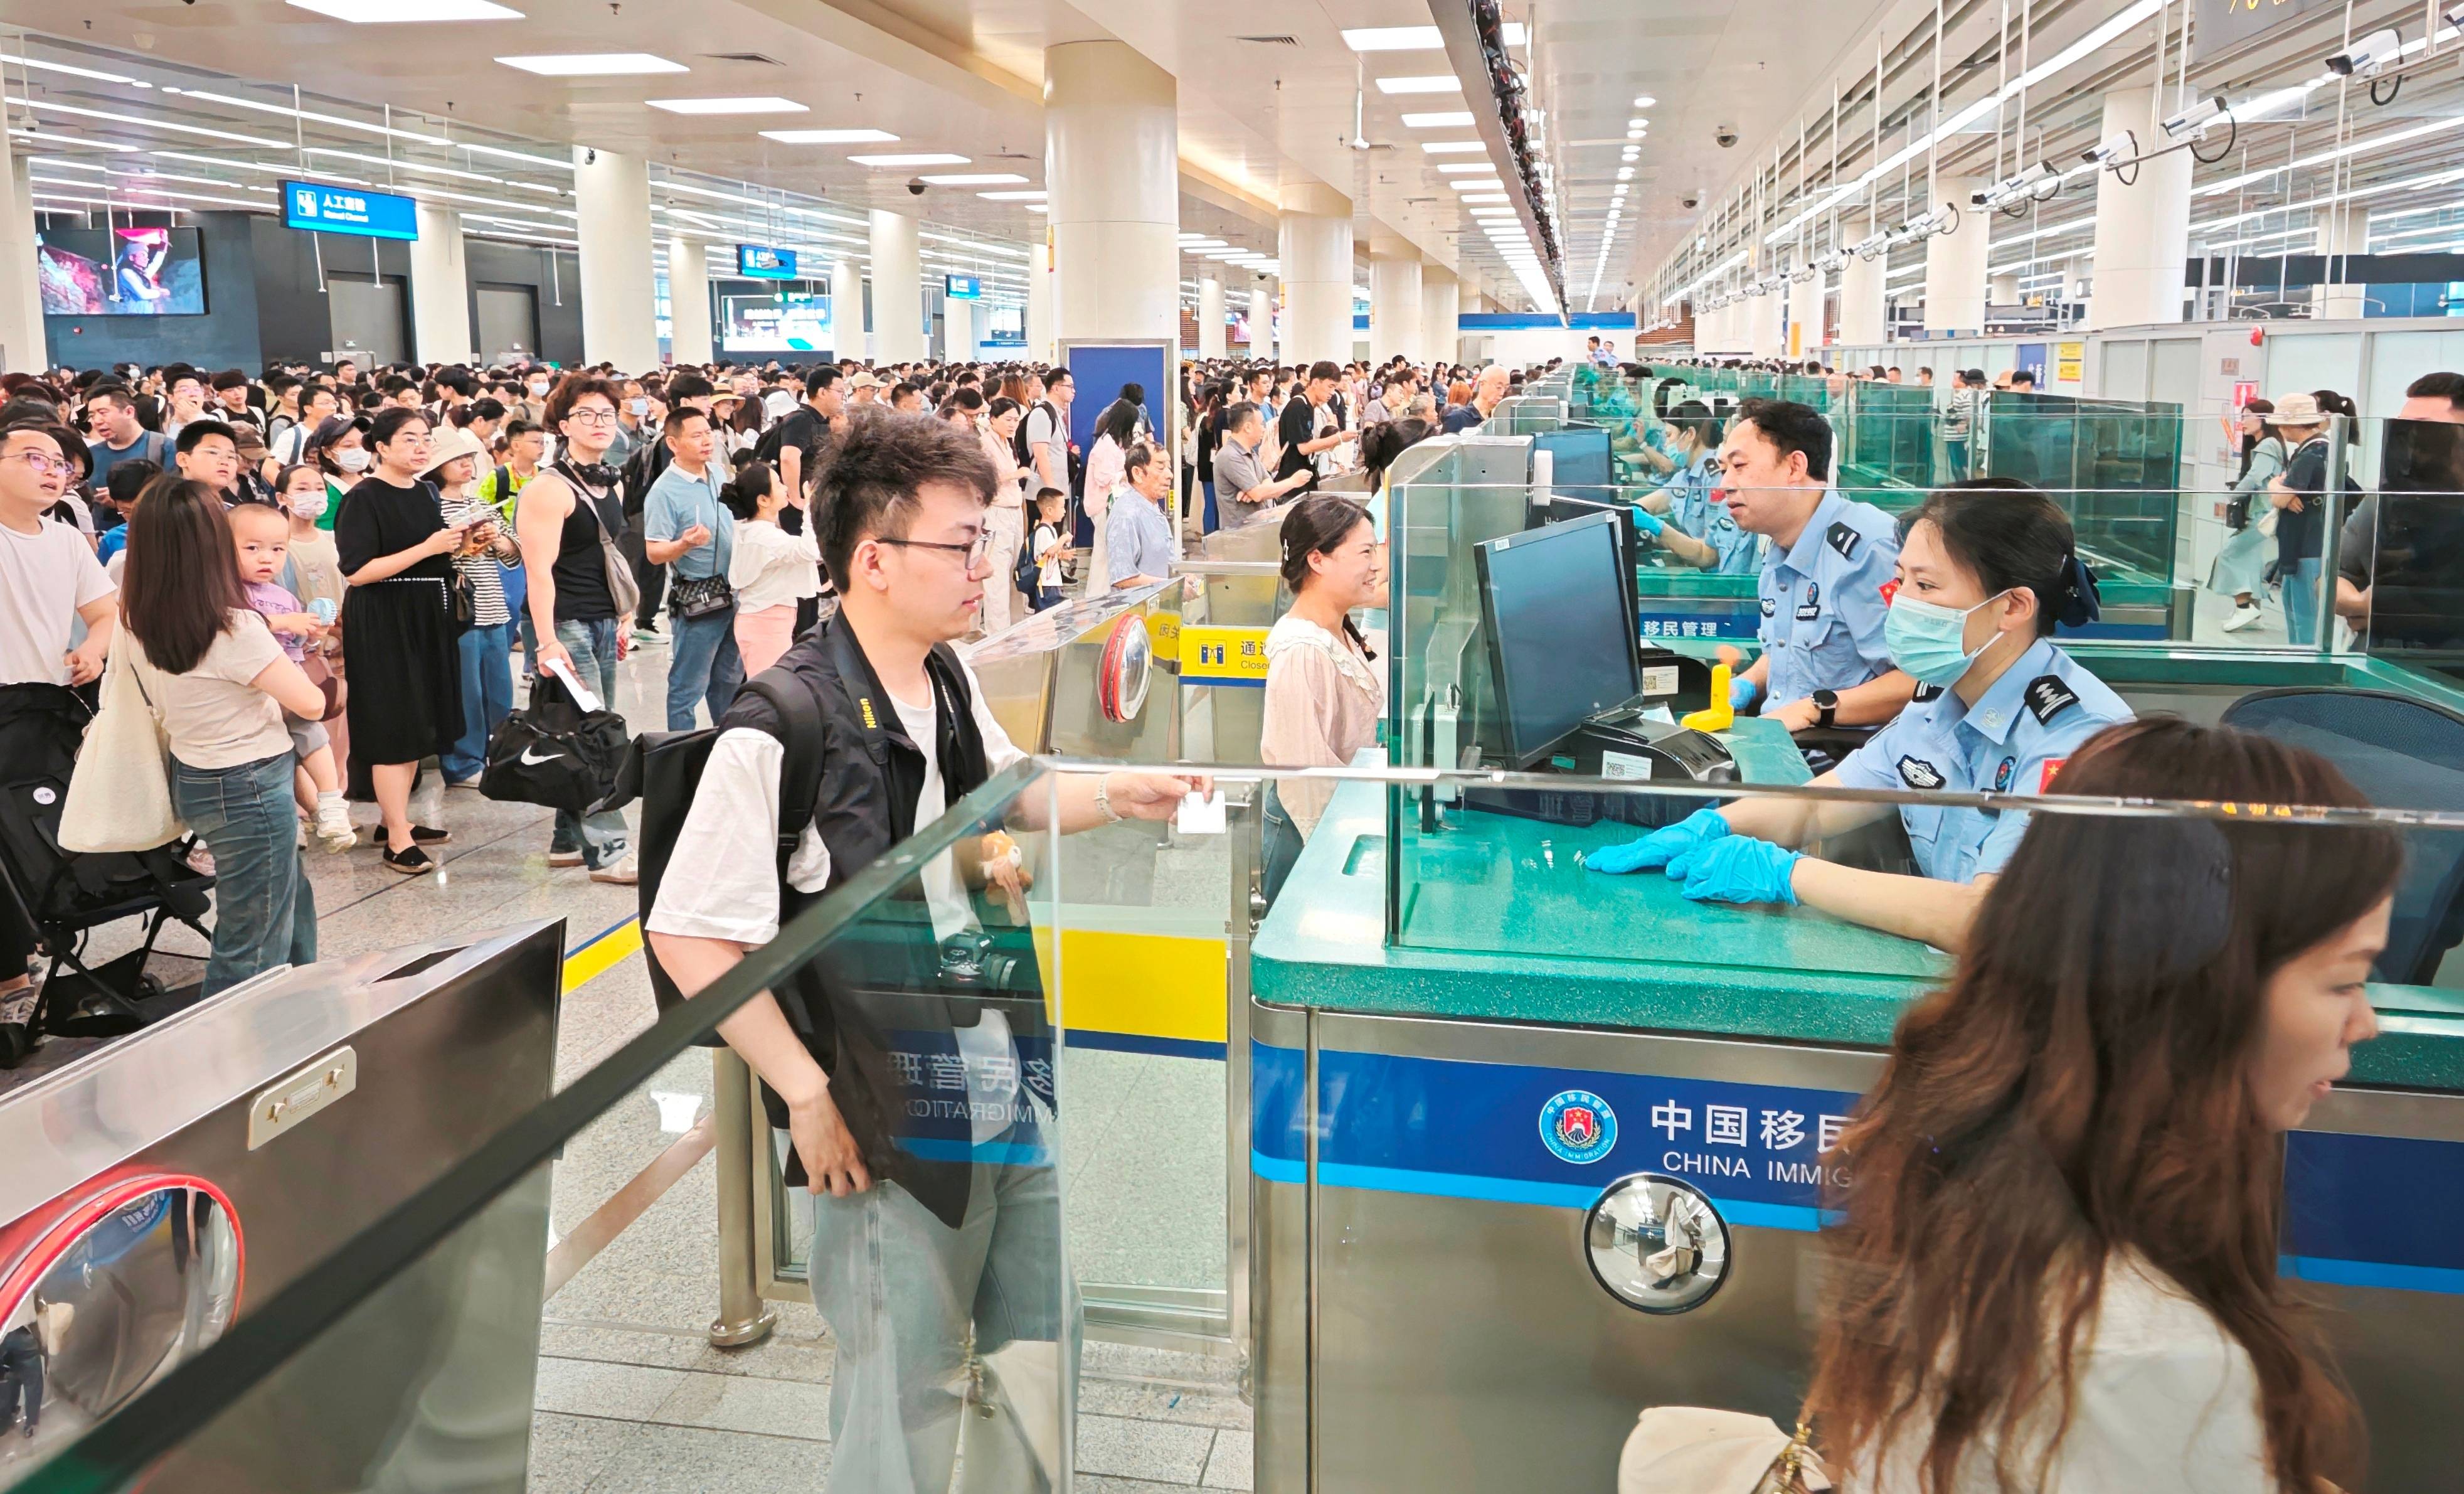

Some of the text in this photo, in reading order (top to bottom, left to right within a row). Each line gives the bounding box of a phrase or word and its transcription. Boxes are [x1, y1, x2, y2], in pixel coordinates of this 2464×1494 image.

[1644, 621, 1718, 637] 移民管理
[1241, 660, 1270, 670] Close
[859, 698, 878, 728] Nikon
[1546, 1133, 1610, 1160] CHINA IMMIGRATION
[1663, 1151, 1751, 1178] CHINA
